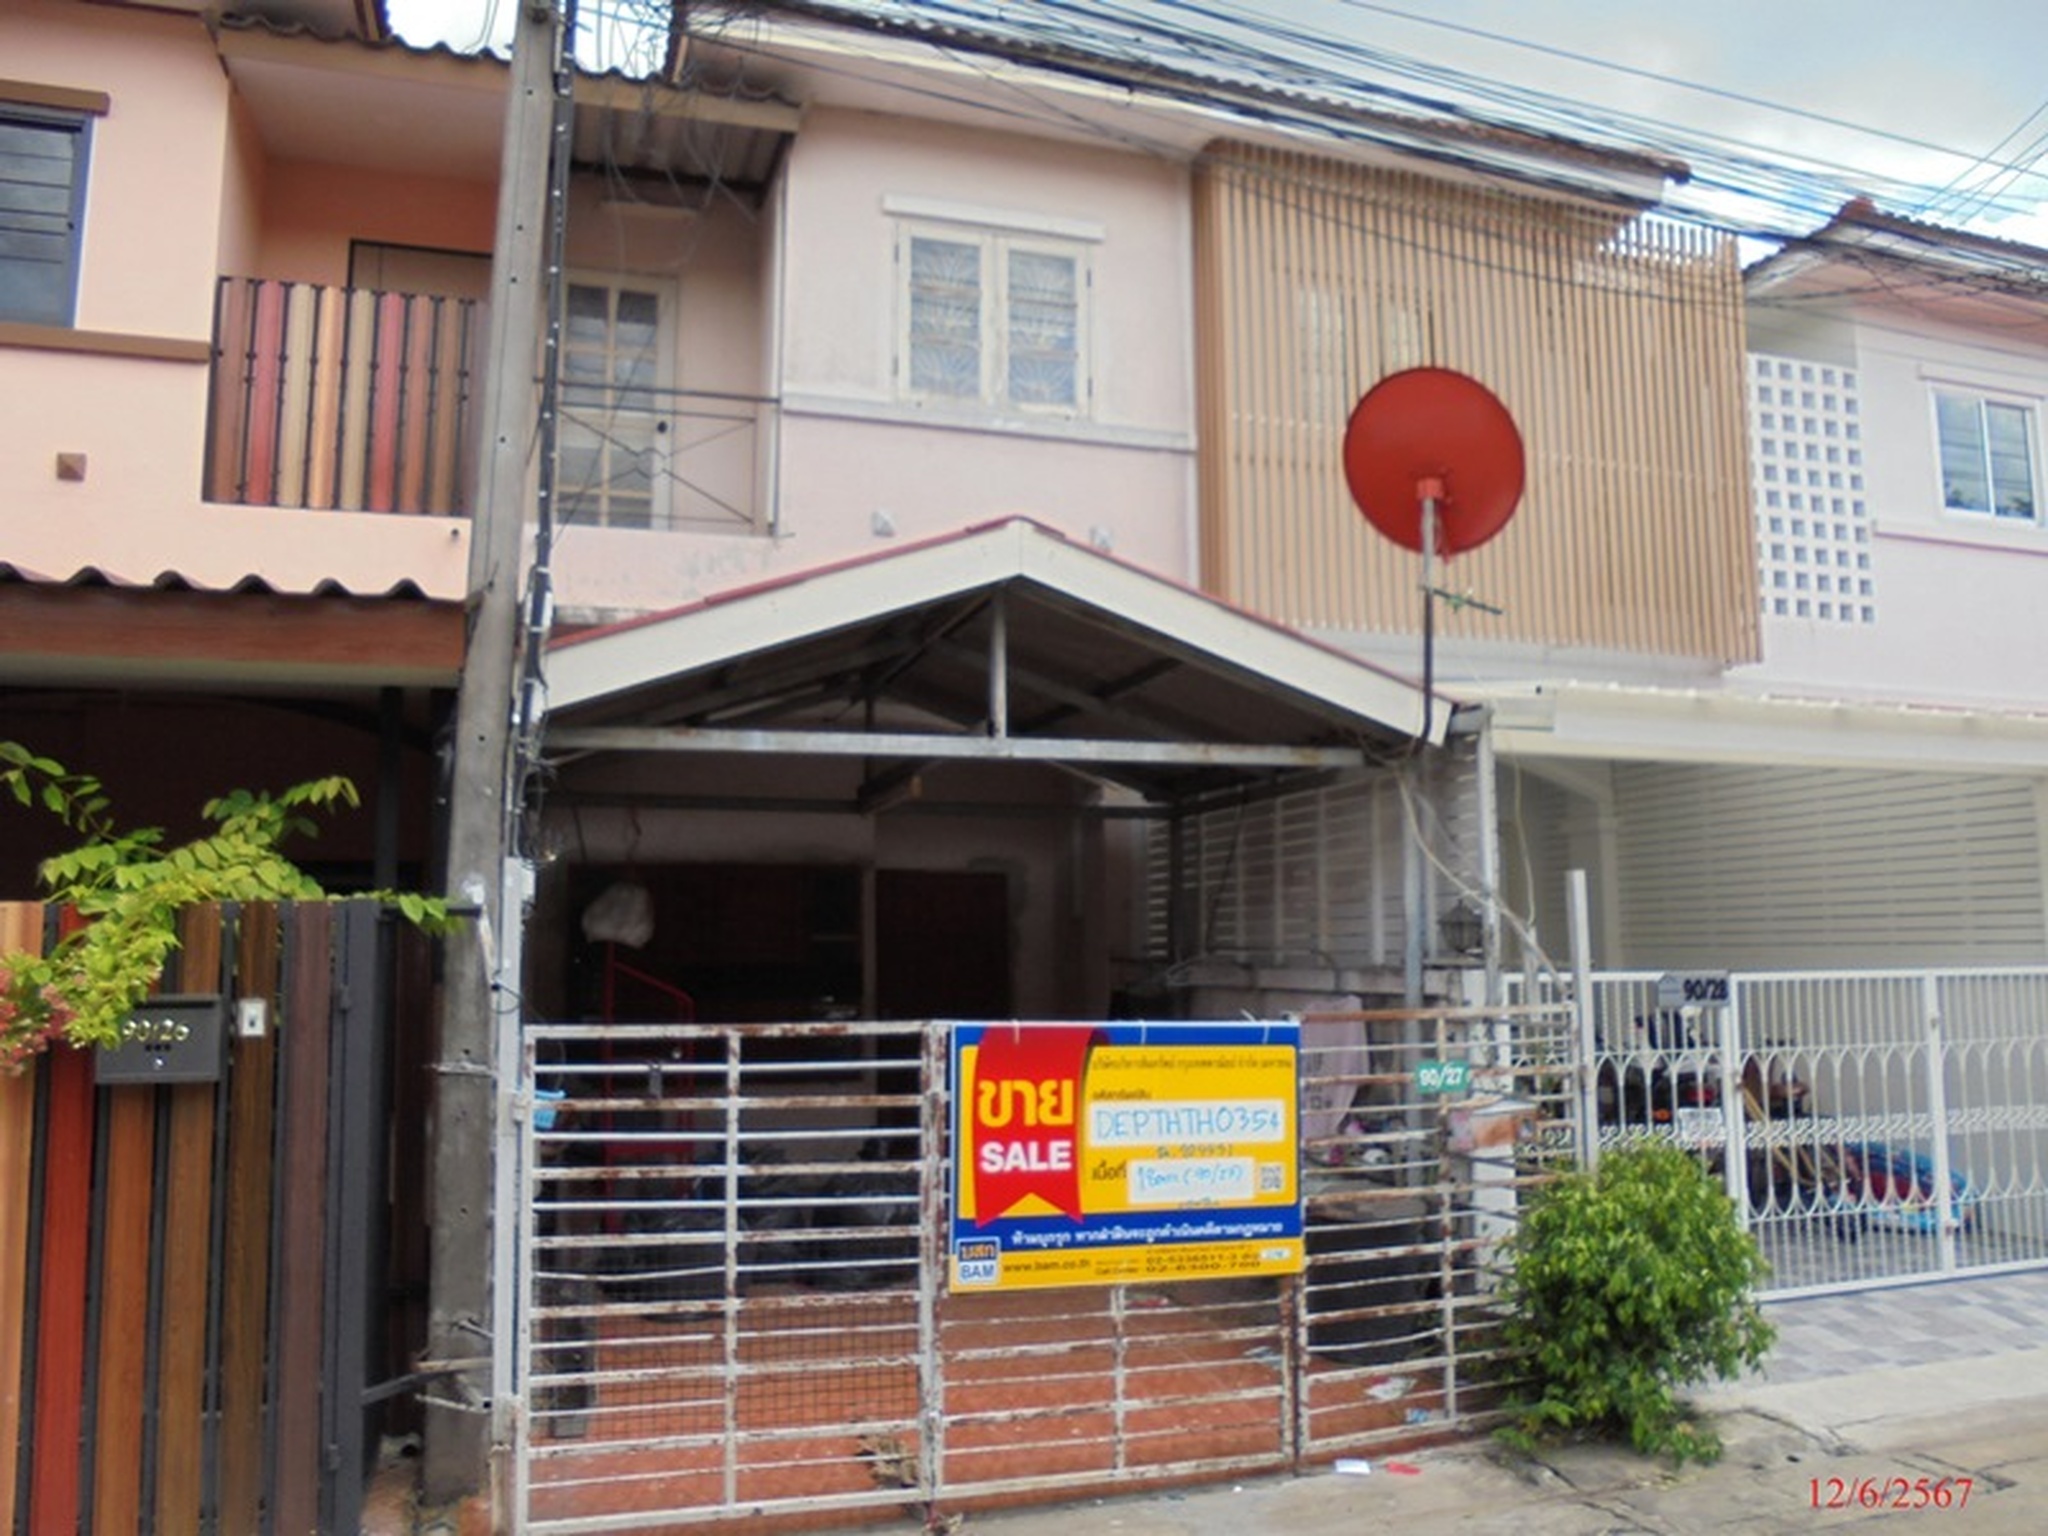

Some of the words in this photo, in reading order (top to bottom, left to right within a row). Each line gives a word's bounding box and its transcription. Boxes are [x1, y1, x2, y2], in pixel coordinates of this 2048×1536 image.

[1684, 979, 1729, 1001] 90/28
[1419, 1064, 1464, 1088] 90/27
[979, 1079, 1073, 1127] ขาย
[980, 1140, 1072, 1173] SALE
[961, 1264, 995, 1280] BAM
[1003, 1259, 1090, 1272] www.bam.co.th
